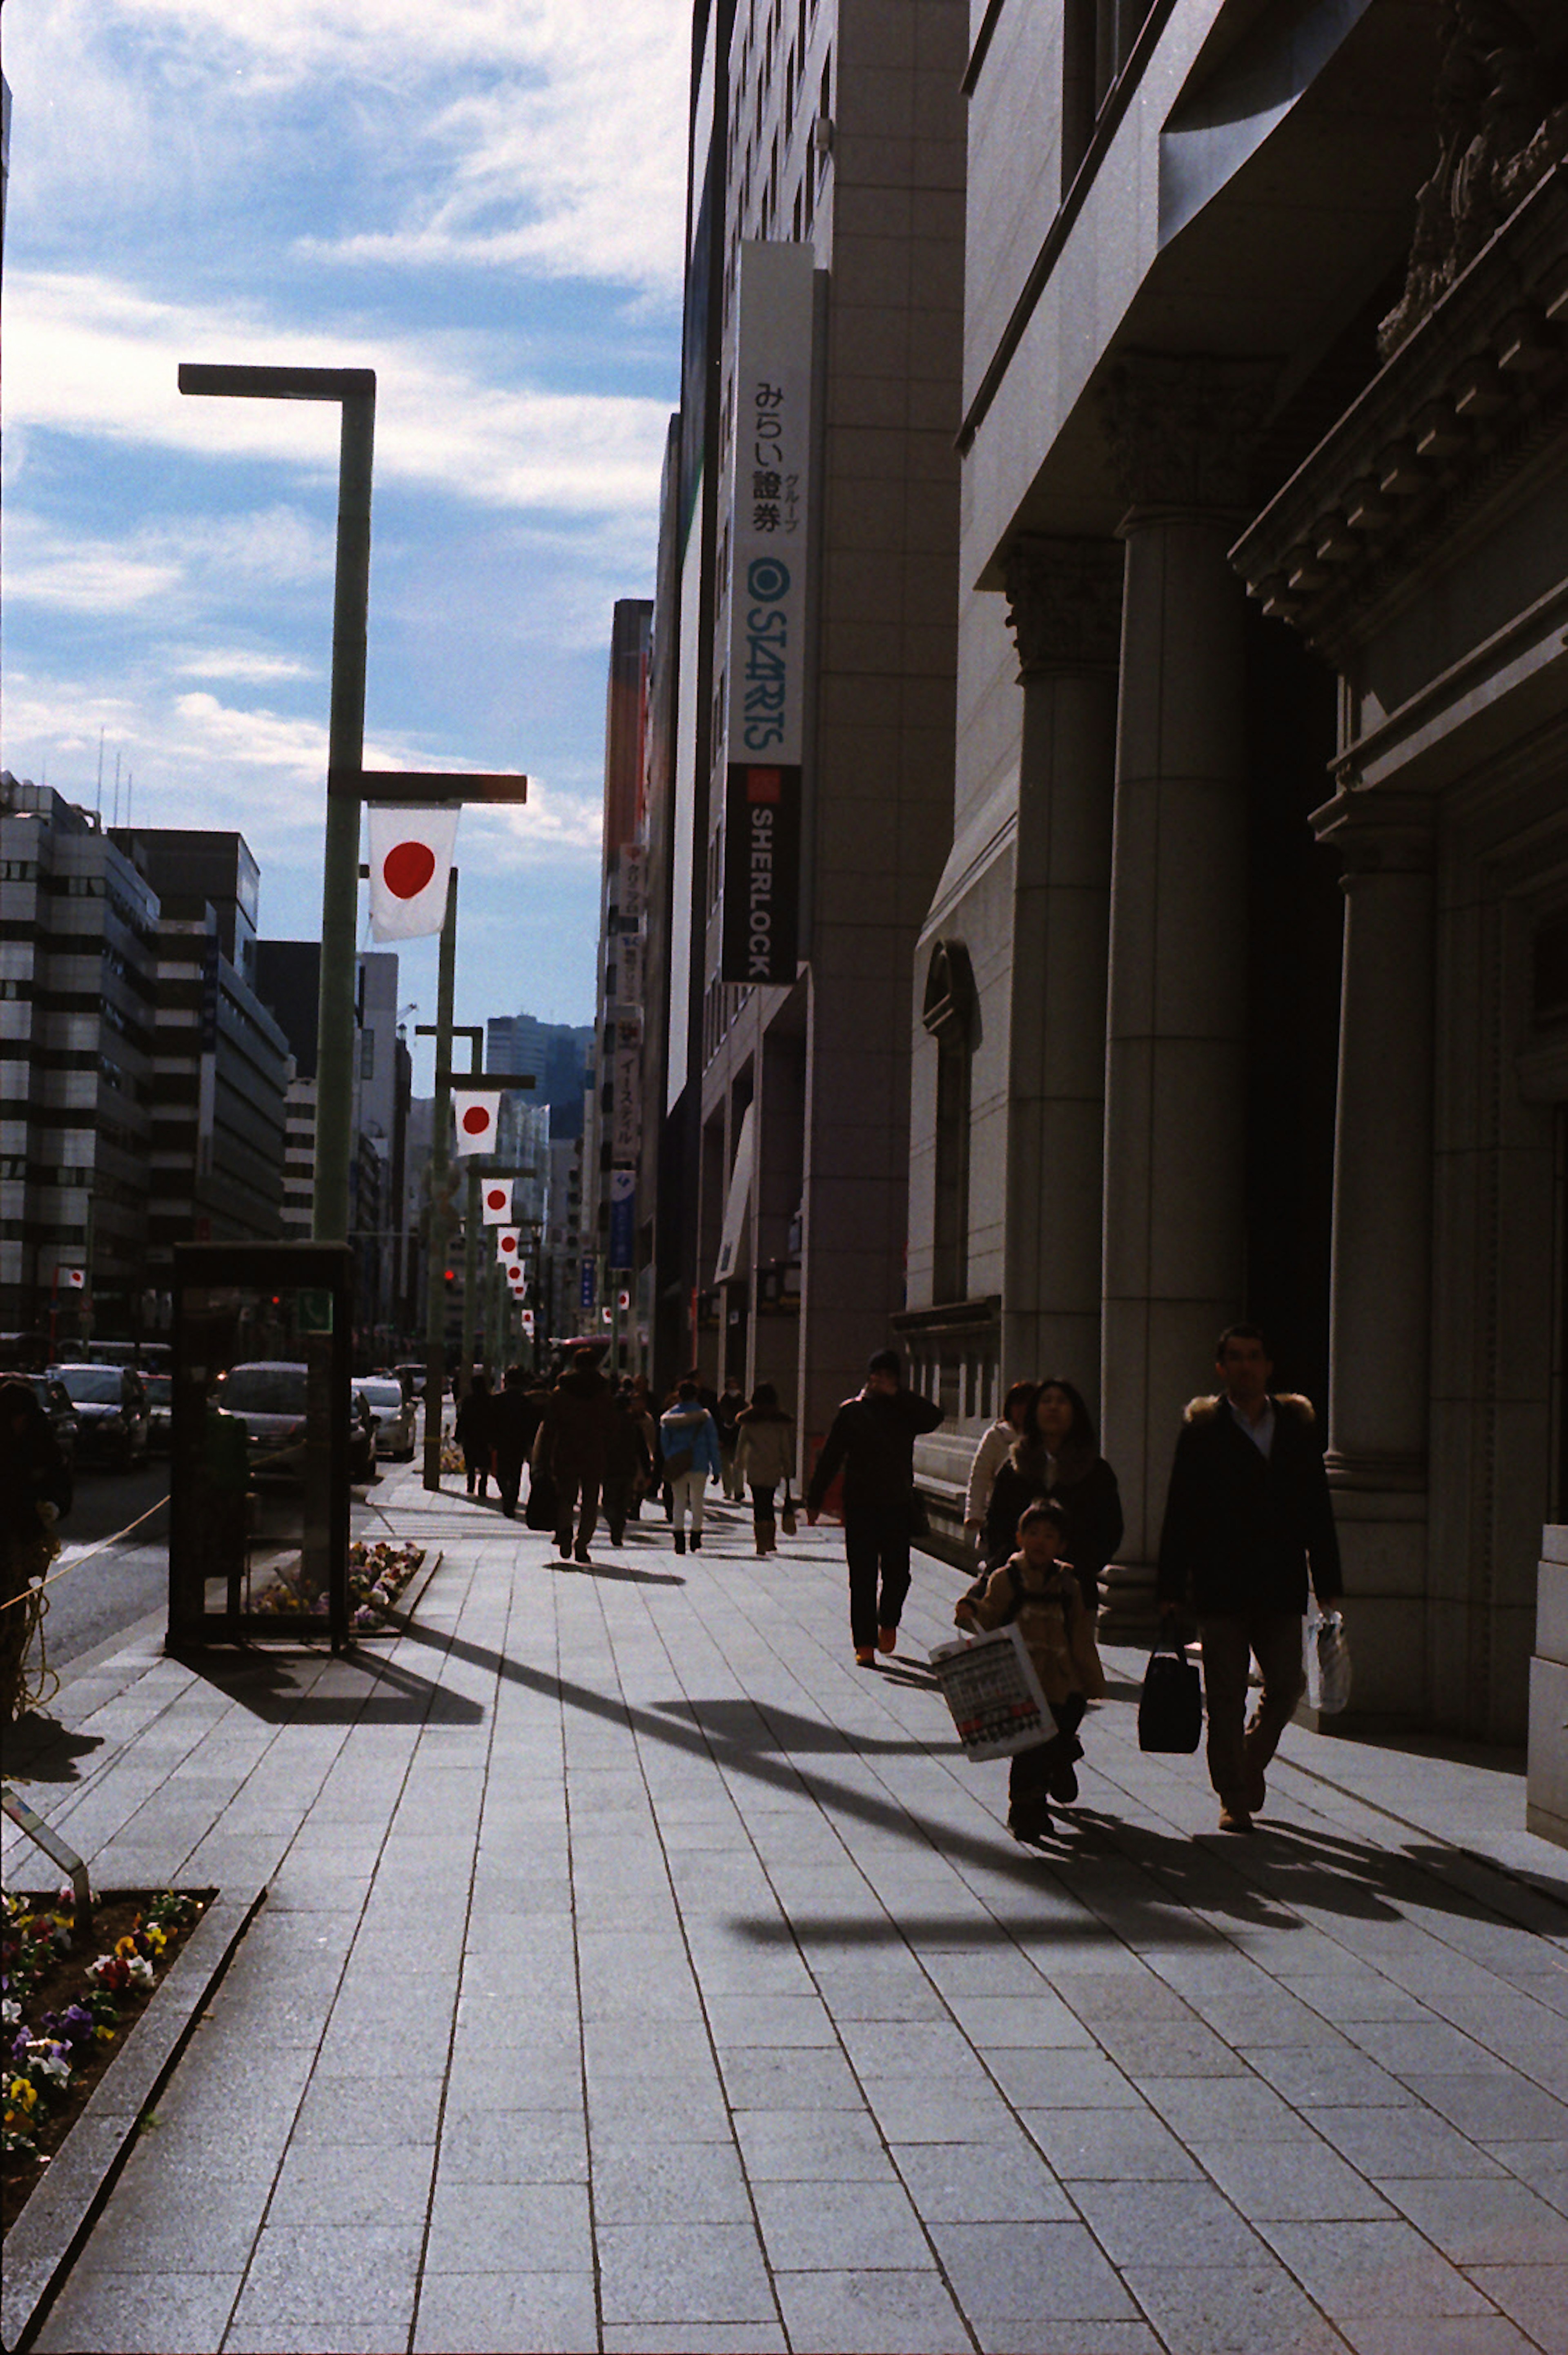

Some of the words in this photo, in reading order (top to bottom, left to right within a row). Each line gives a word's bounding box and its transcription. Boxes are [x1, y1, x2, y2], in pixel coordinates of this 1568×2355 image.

[785, 473, 800, 534] グループ
[744, 608, 787, 751] STARTS
[748, 808, 774, 977] SHERLOCK
